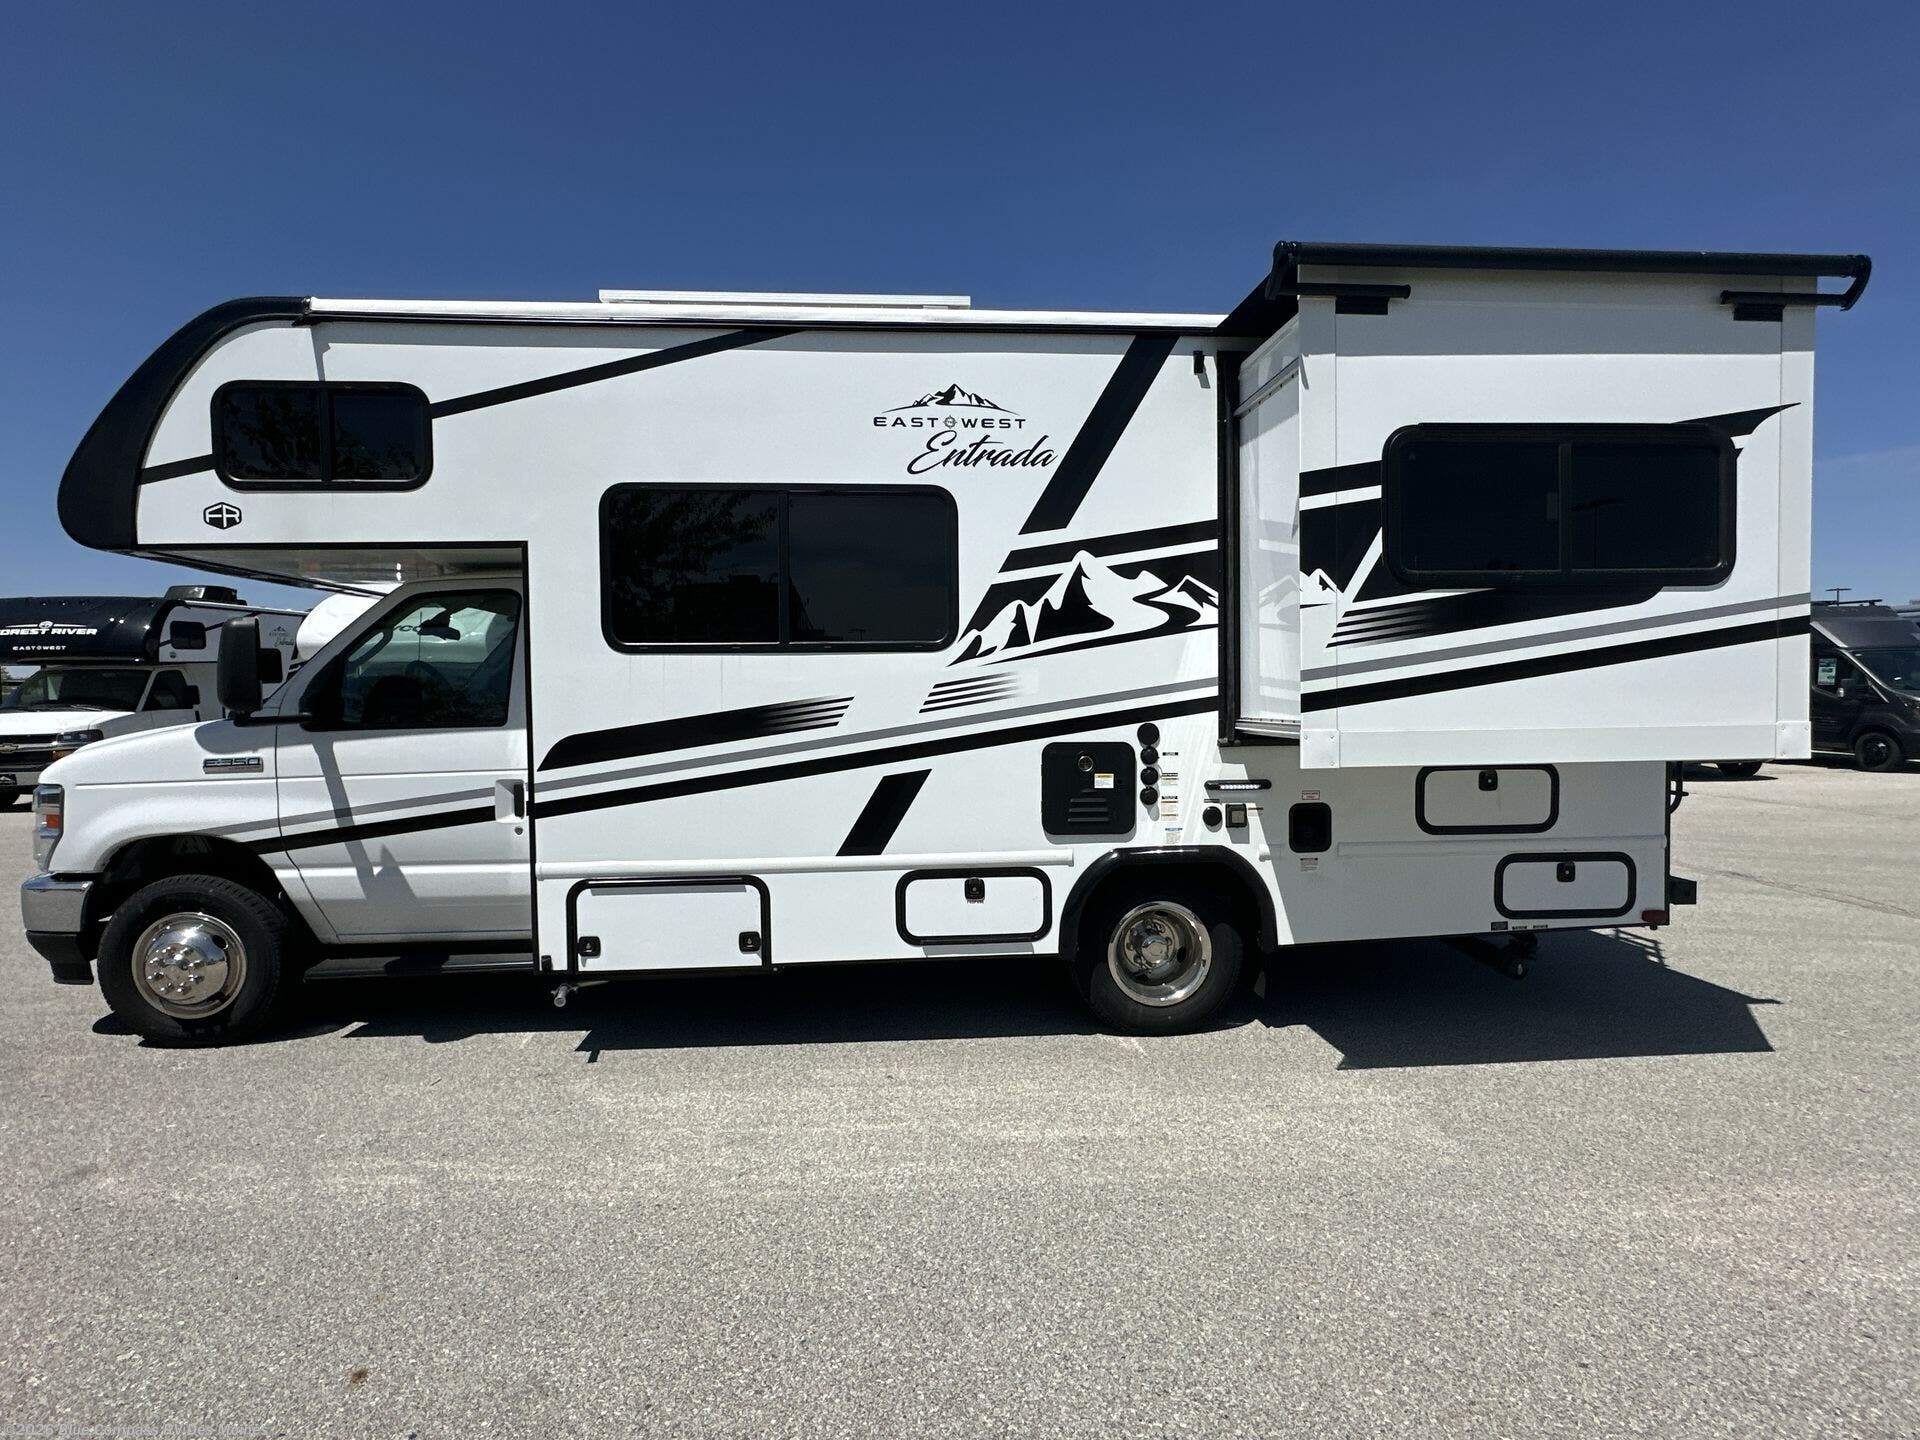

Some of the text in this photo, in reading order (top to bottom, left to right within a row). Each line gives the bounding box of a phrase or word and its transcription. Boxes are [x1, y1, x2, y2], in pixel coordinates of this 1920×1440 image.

[873, 416, 1026, 429] EAST WEST
[907, 429, 1059, 475] Entrada
